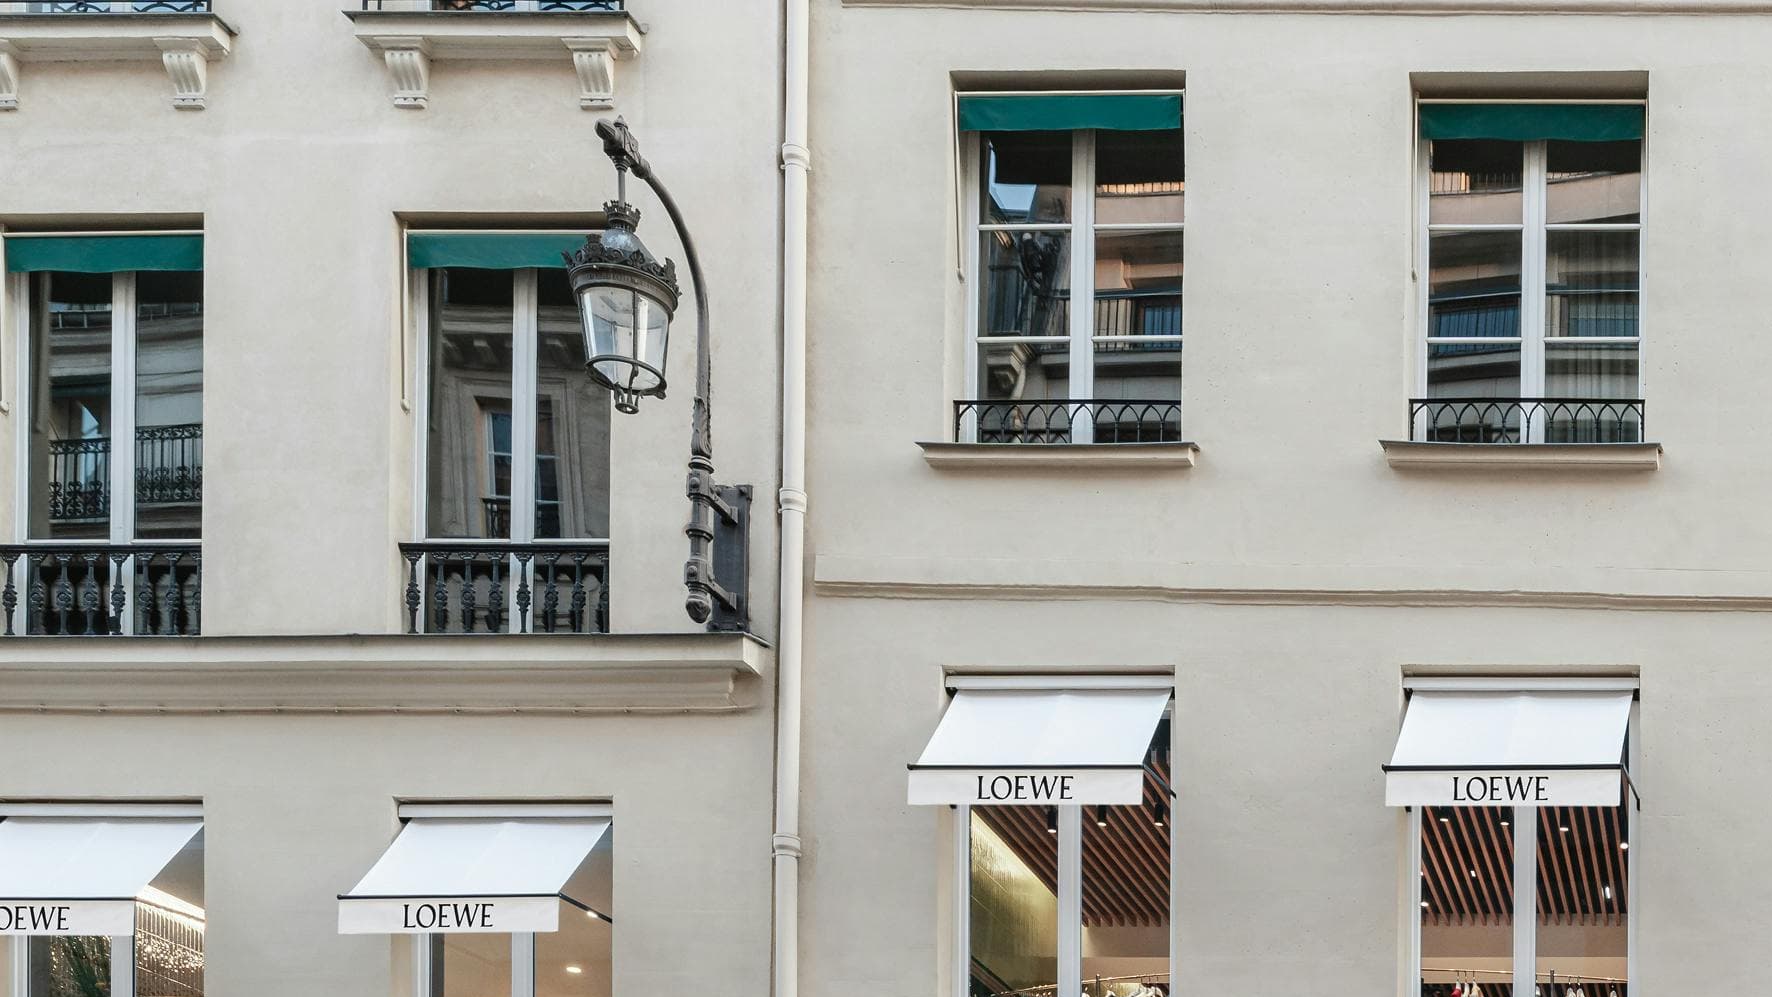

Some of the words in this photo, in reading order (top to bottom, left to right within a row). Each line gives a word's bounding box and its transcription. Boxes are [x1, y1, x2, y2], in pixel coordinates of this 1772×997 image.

[977, 775, 1074, 800] LOEWE
[1453, 776, 1549, 802] LOEWE
[0, 906, 70, 931] OEWE
[403, 903, 494, 929] LOEWE
